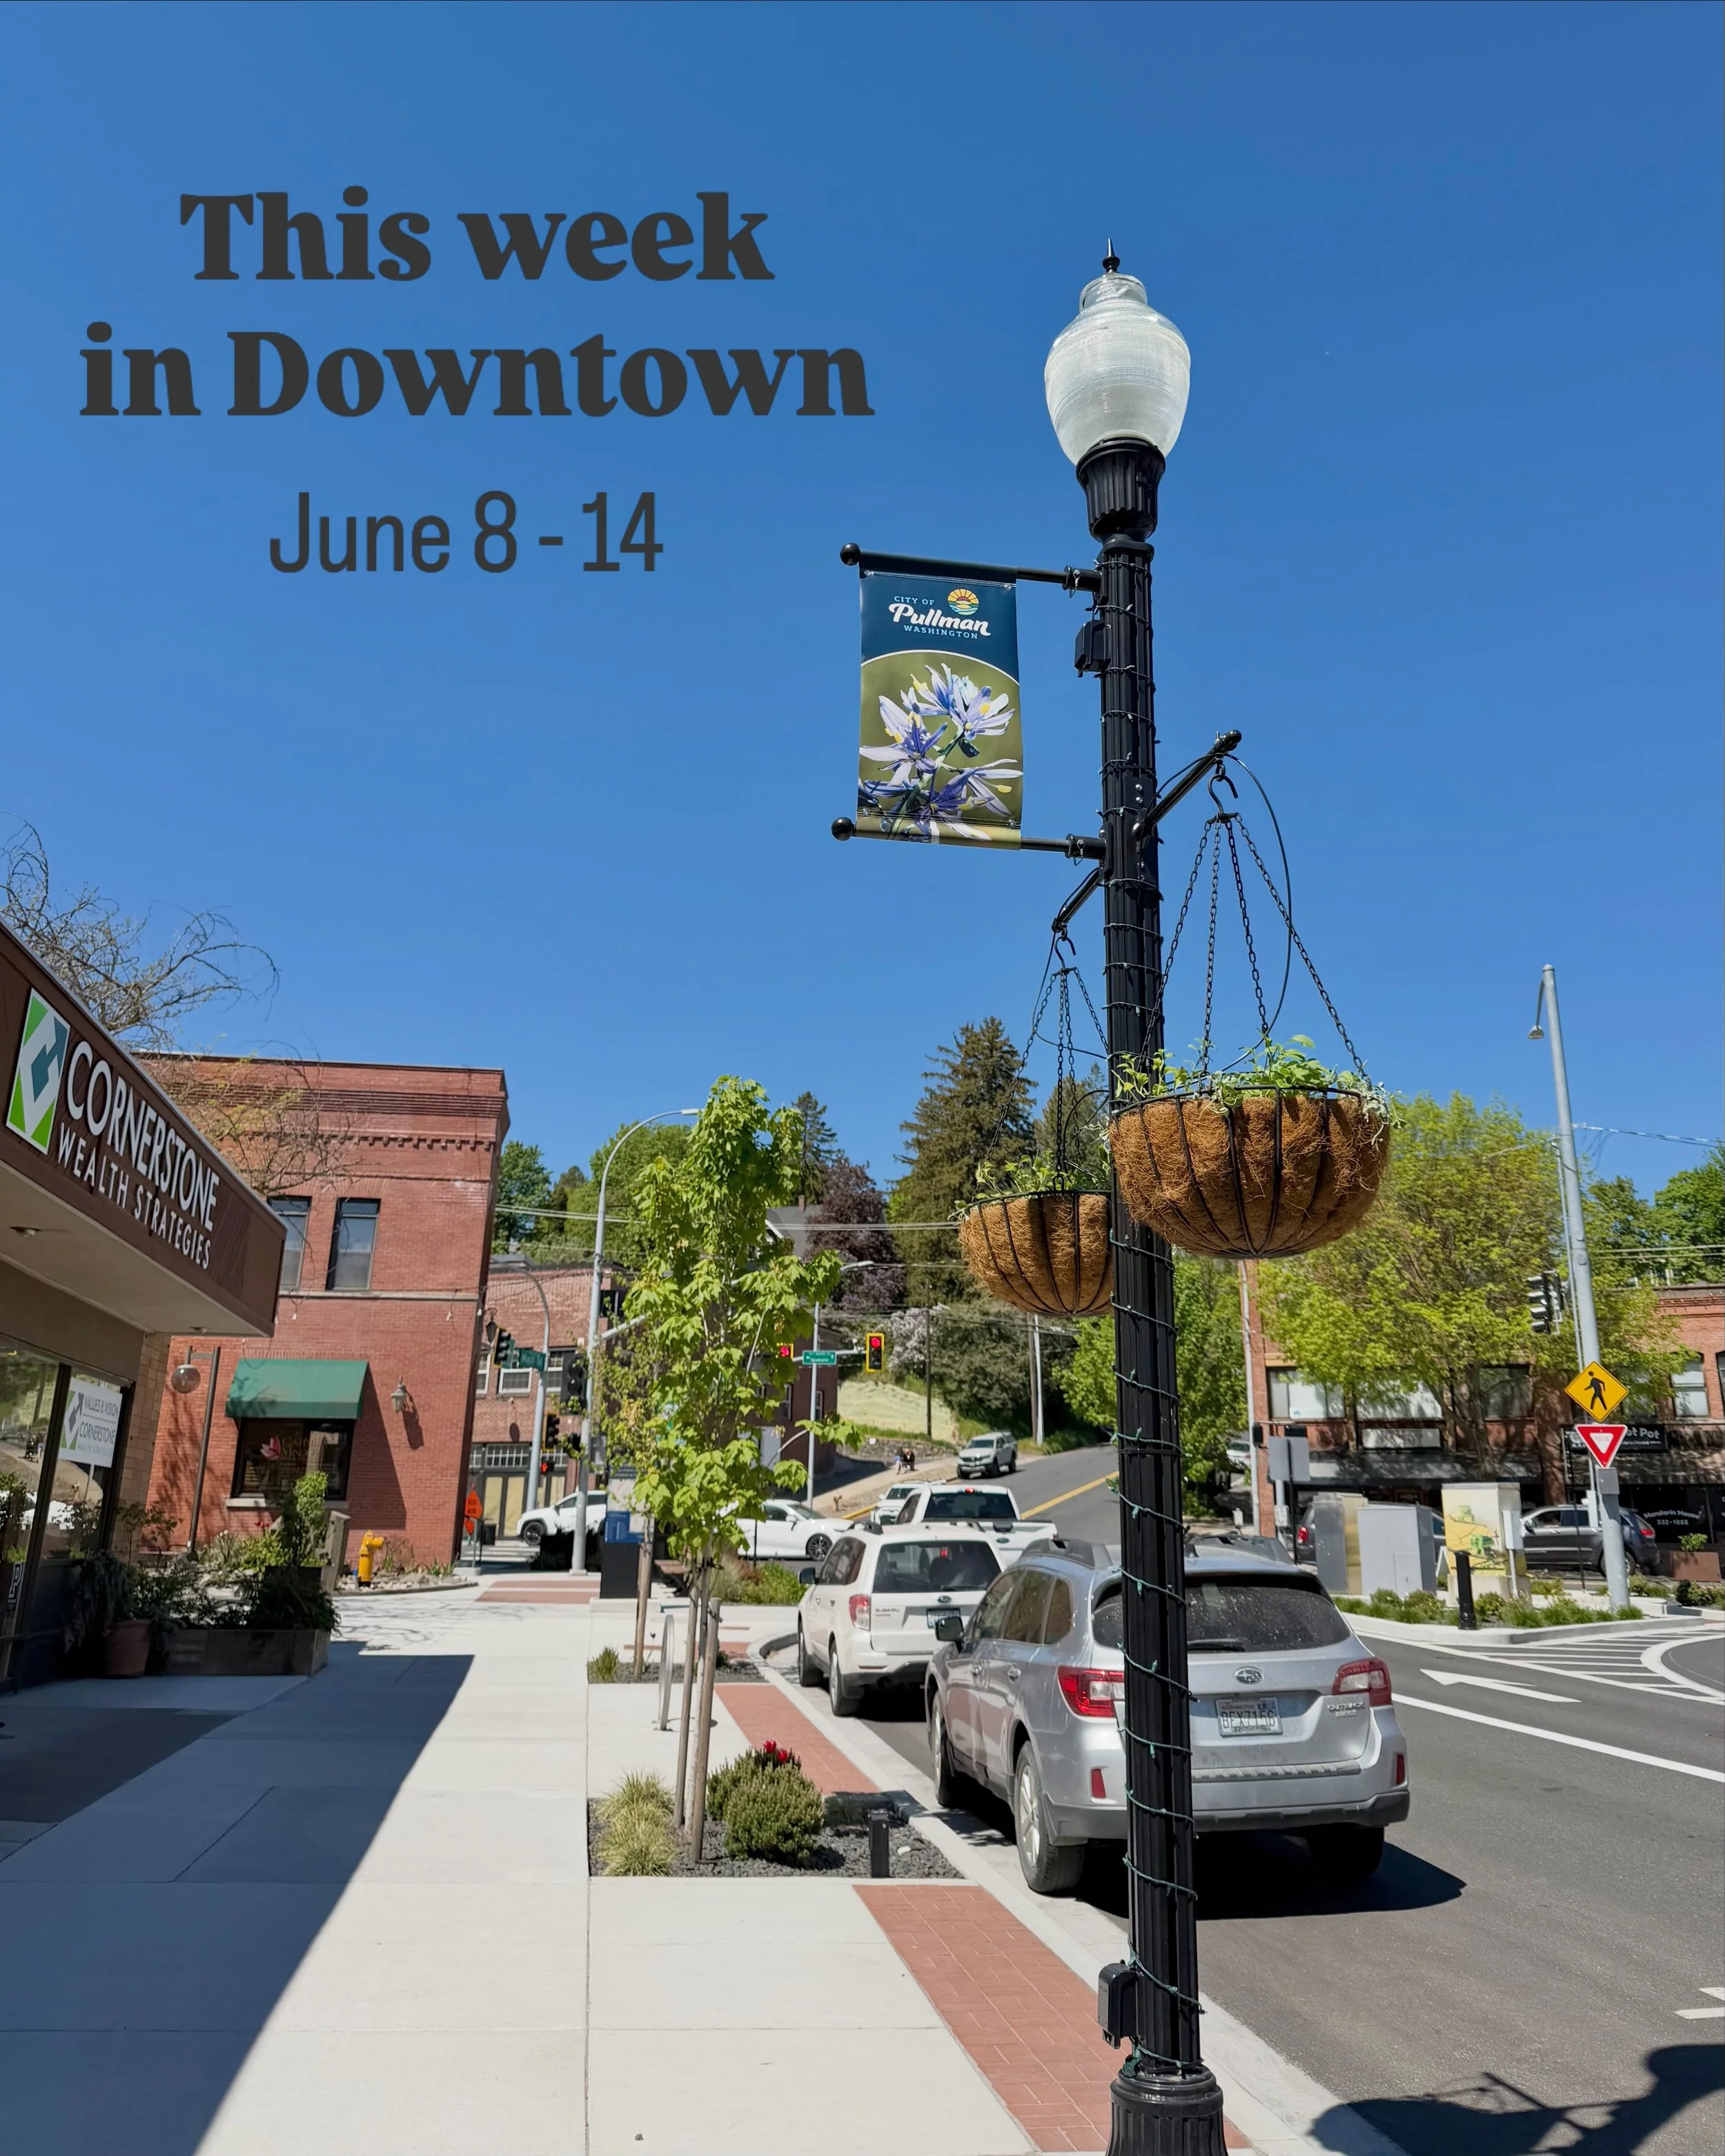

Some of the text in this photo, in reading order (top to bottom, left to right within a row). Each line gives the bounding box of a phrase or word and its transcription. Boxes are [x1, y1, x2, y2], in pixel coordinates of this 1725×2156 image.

[894, 595, 918, 604] CITY
[889, 603, 992, 636] Pullman
[904, 625, 978, 639] WASHINGTON
[67, 1040, 219, 1232] CORNERSTONE
[58, 1122, 211, 1269] WEALTH STRATEGIES
[84, 1395, 101, 1412] VALUES
[79, 1422, 116, 1445] CORNERSTONE
[1626, 1427, 1660, 1439] ot Pot
[1643, 1510, 1700, 1519] Mandarin House
